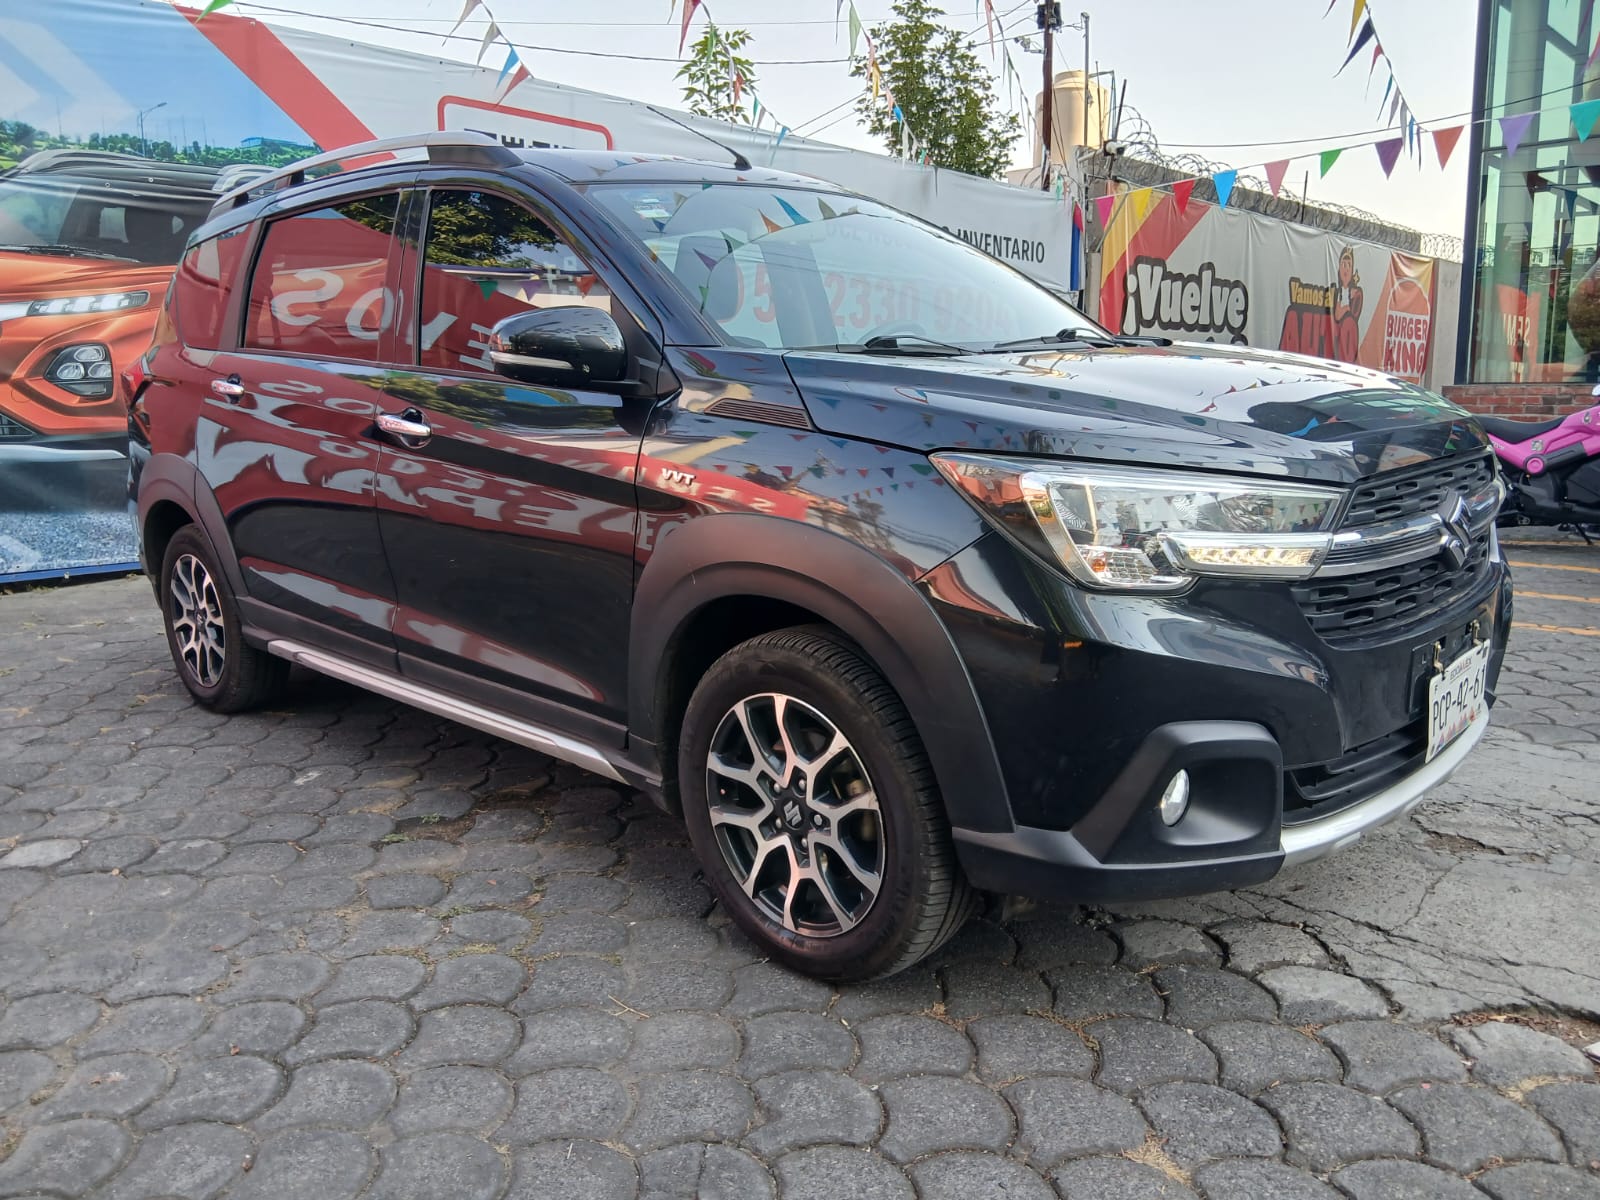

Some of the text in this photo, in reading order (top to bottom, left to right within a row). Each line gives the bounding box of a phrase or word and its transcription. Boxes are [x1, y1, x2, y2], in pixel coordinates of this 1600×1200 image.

[1290, 280, 1324, 307] Vamos
[1280, 309, 1358, 362] AUTO
[1386, 313, 1427, 343] BURGER
[1383, 339, 1426, 373] KING
[661, 467, 695, 485] VVT
[1432, 664, 1485, 737] PCP-42-61
